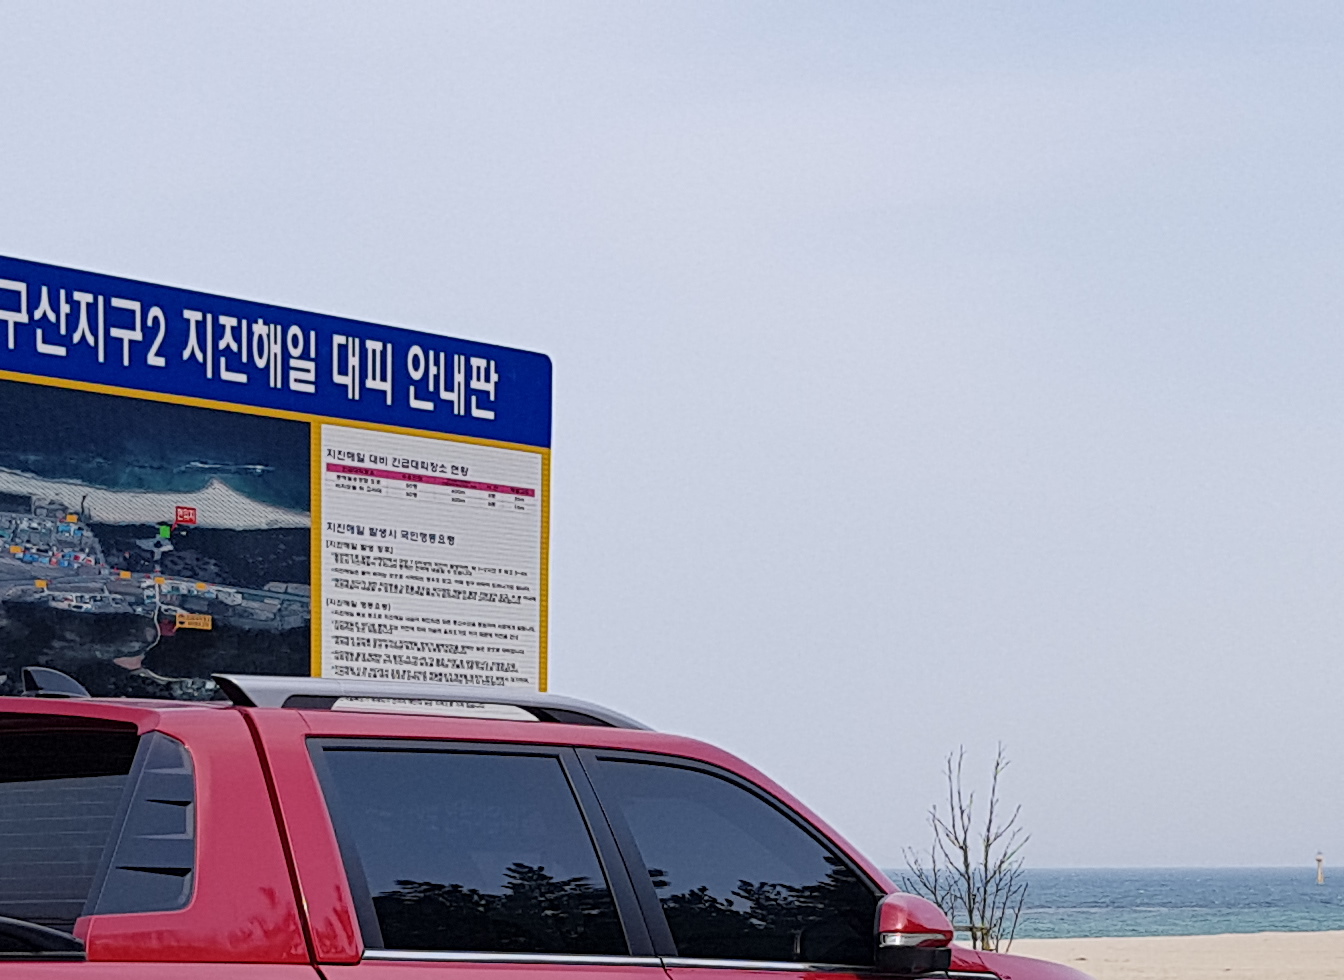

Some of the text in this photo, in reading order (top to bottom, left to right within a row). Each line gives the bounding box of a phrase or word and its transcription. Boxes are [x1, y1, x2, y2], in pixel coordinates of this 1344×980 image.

[182, 309, 316, 393] 지진해일
[332, 334, 393, 406] 대피
[407, 345, 499, 420] 안내판
[326, 448, 469, 477] 지진해일 대비 긴급대피장소 현황
[326, 521, 456, 546] 지진해일 발생시 국민행동요령
